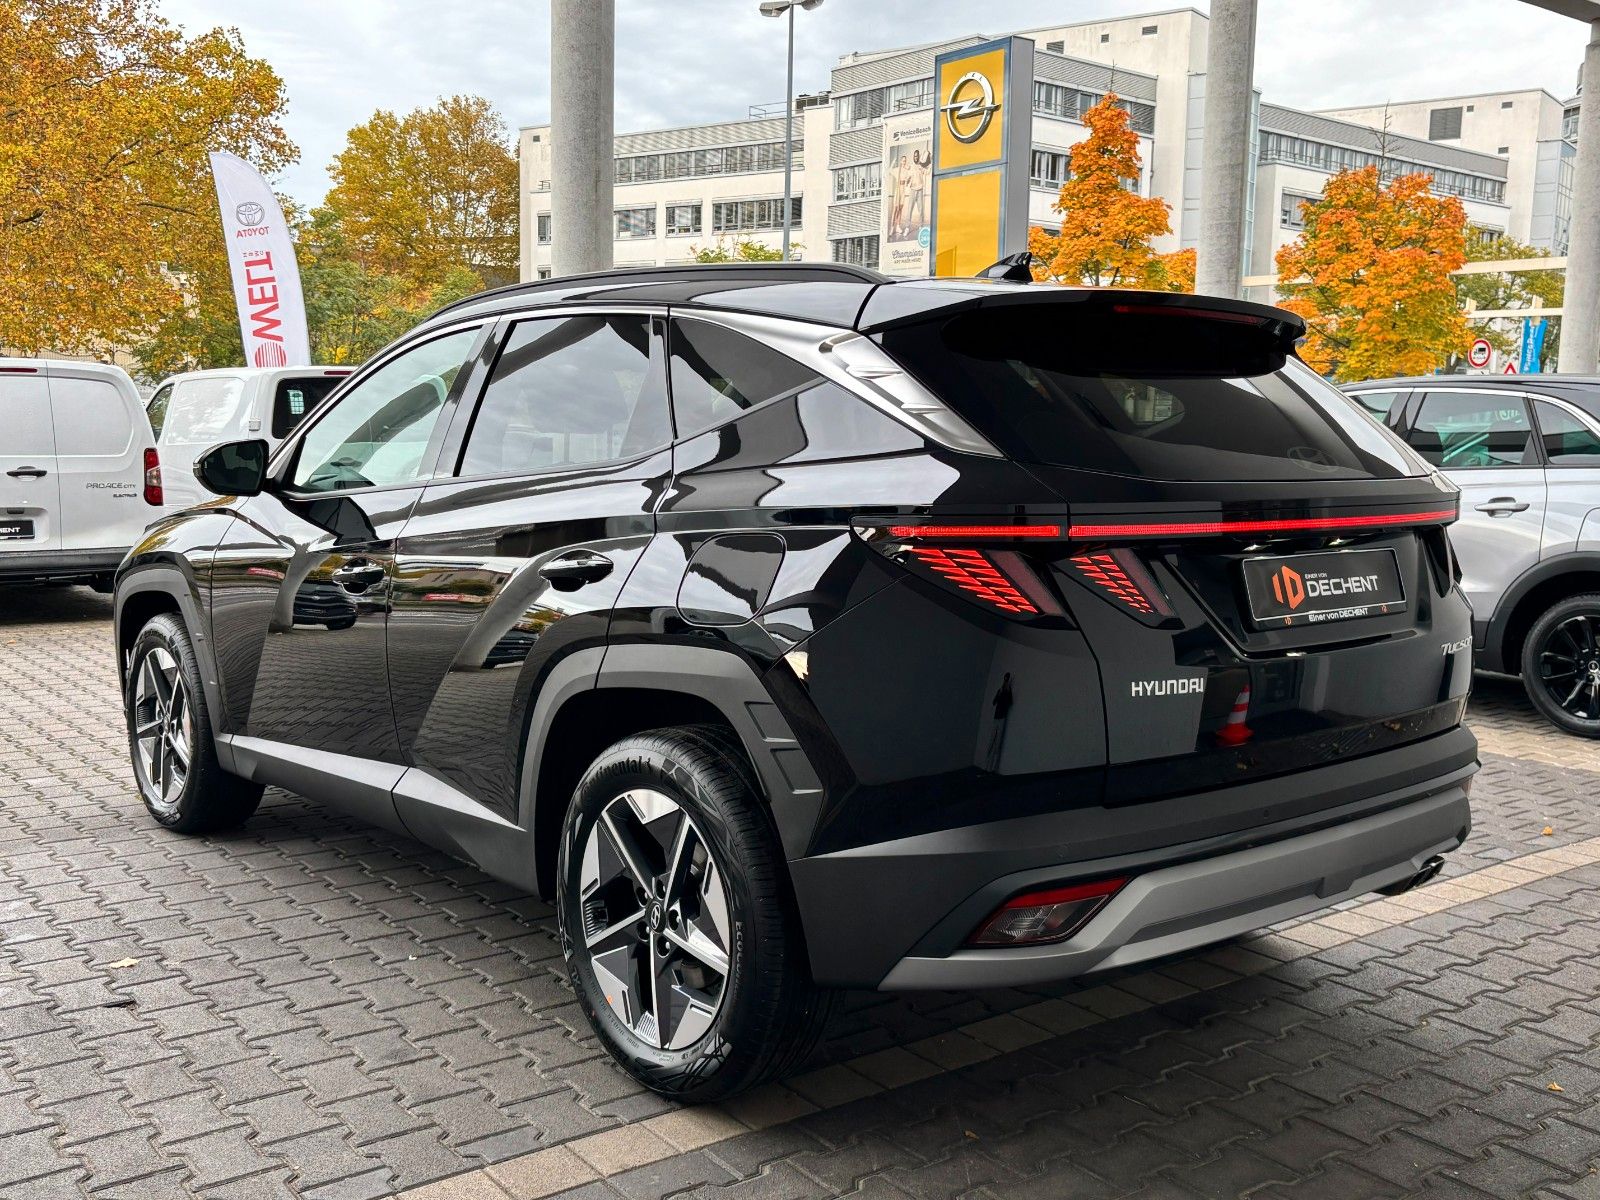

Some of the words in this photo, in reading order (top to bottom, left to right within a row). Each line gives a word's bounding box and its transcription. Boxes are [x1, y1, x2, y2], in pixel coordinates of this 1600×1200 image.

[1306, 575, 1379, 598] DECHENT
[1308, 612, 1326, 622] Einer
[1326, 611, 1339, 620] von
[1339, 607, 1369, 618] DECHENT
[1131, 677, 1204, 697] HYUNDAI
